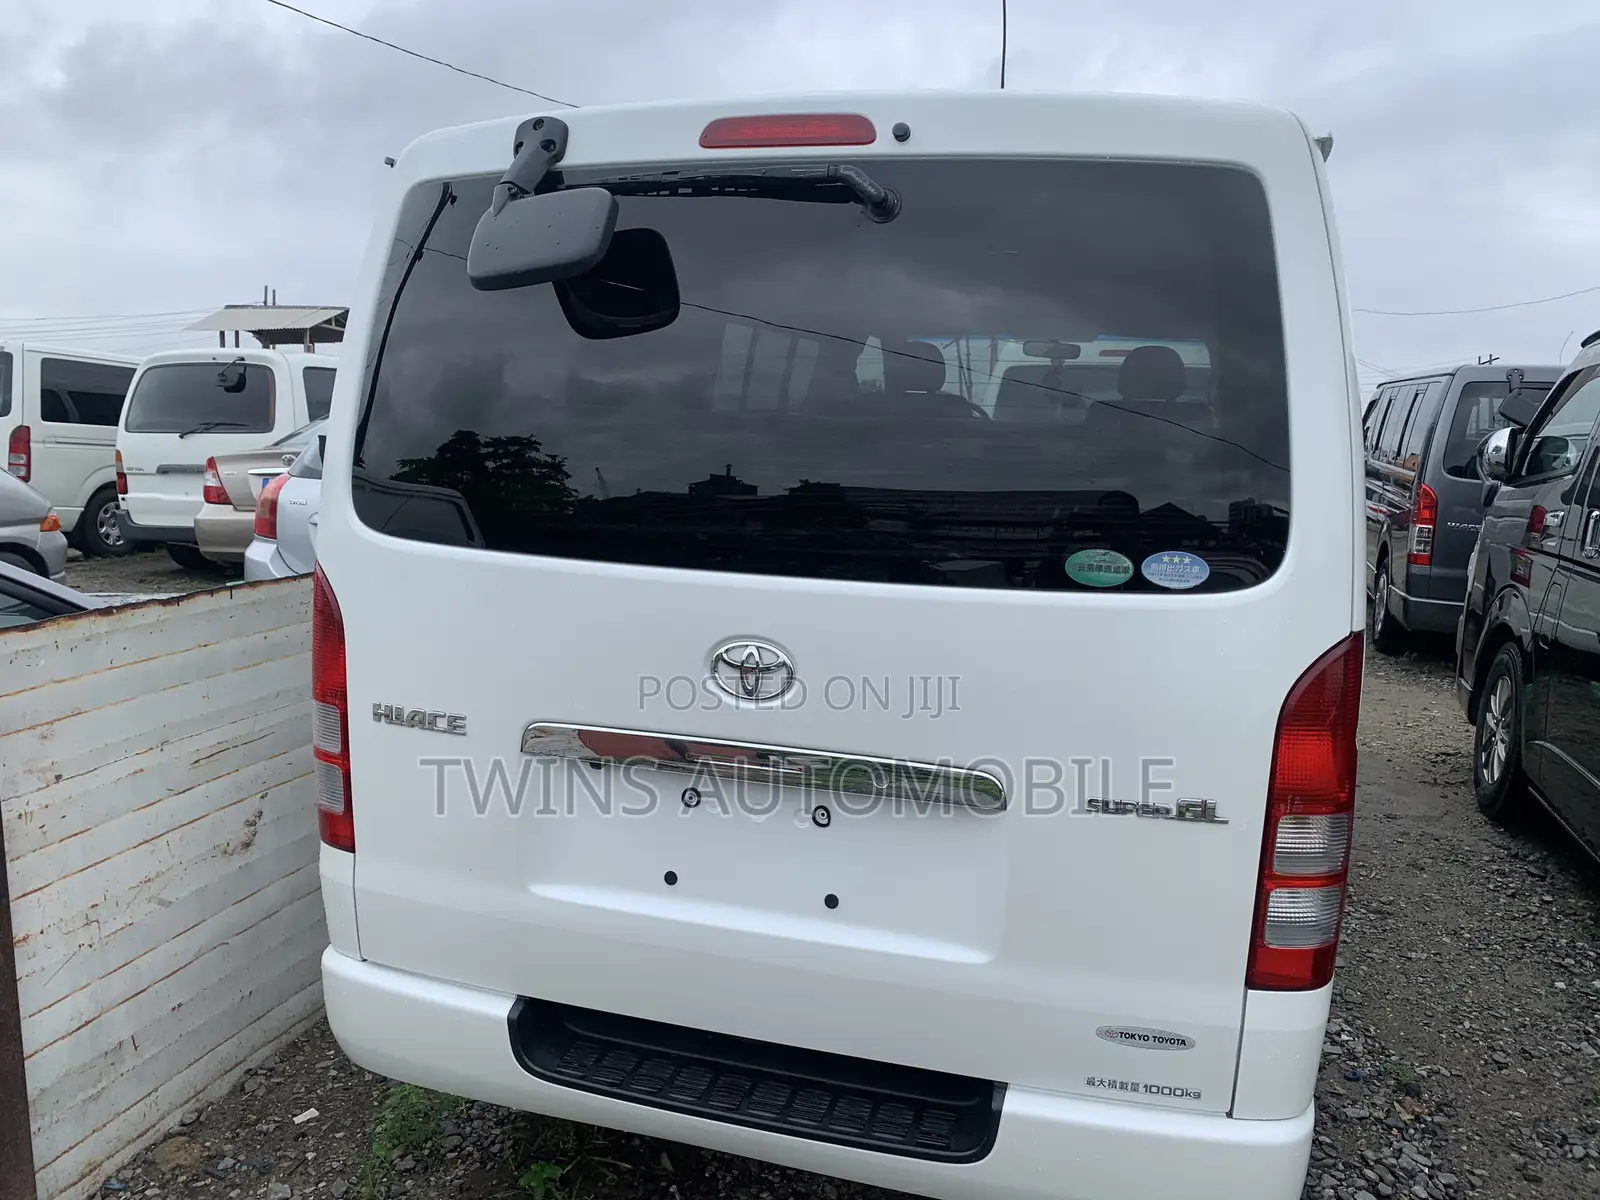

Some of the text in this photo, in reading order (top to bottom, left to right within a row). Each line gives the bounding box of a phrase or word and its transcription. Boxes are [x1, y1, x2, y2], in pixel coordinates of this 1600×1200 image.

[372, 701, 467, 736] HIACE
[1119, 1031, 1187, 1047] TOKYO TOYOTA
[1086, 1076, 1201, 1099] 最大積載量 1000kg
